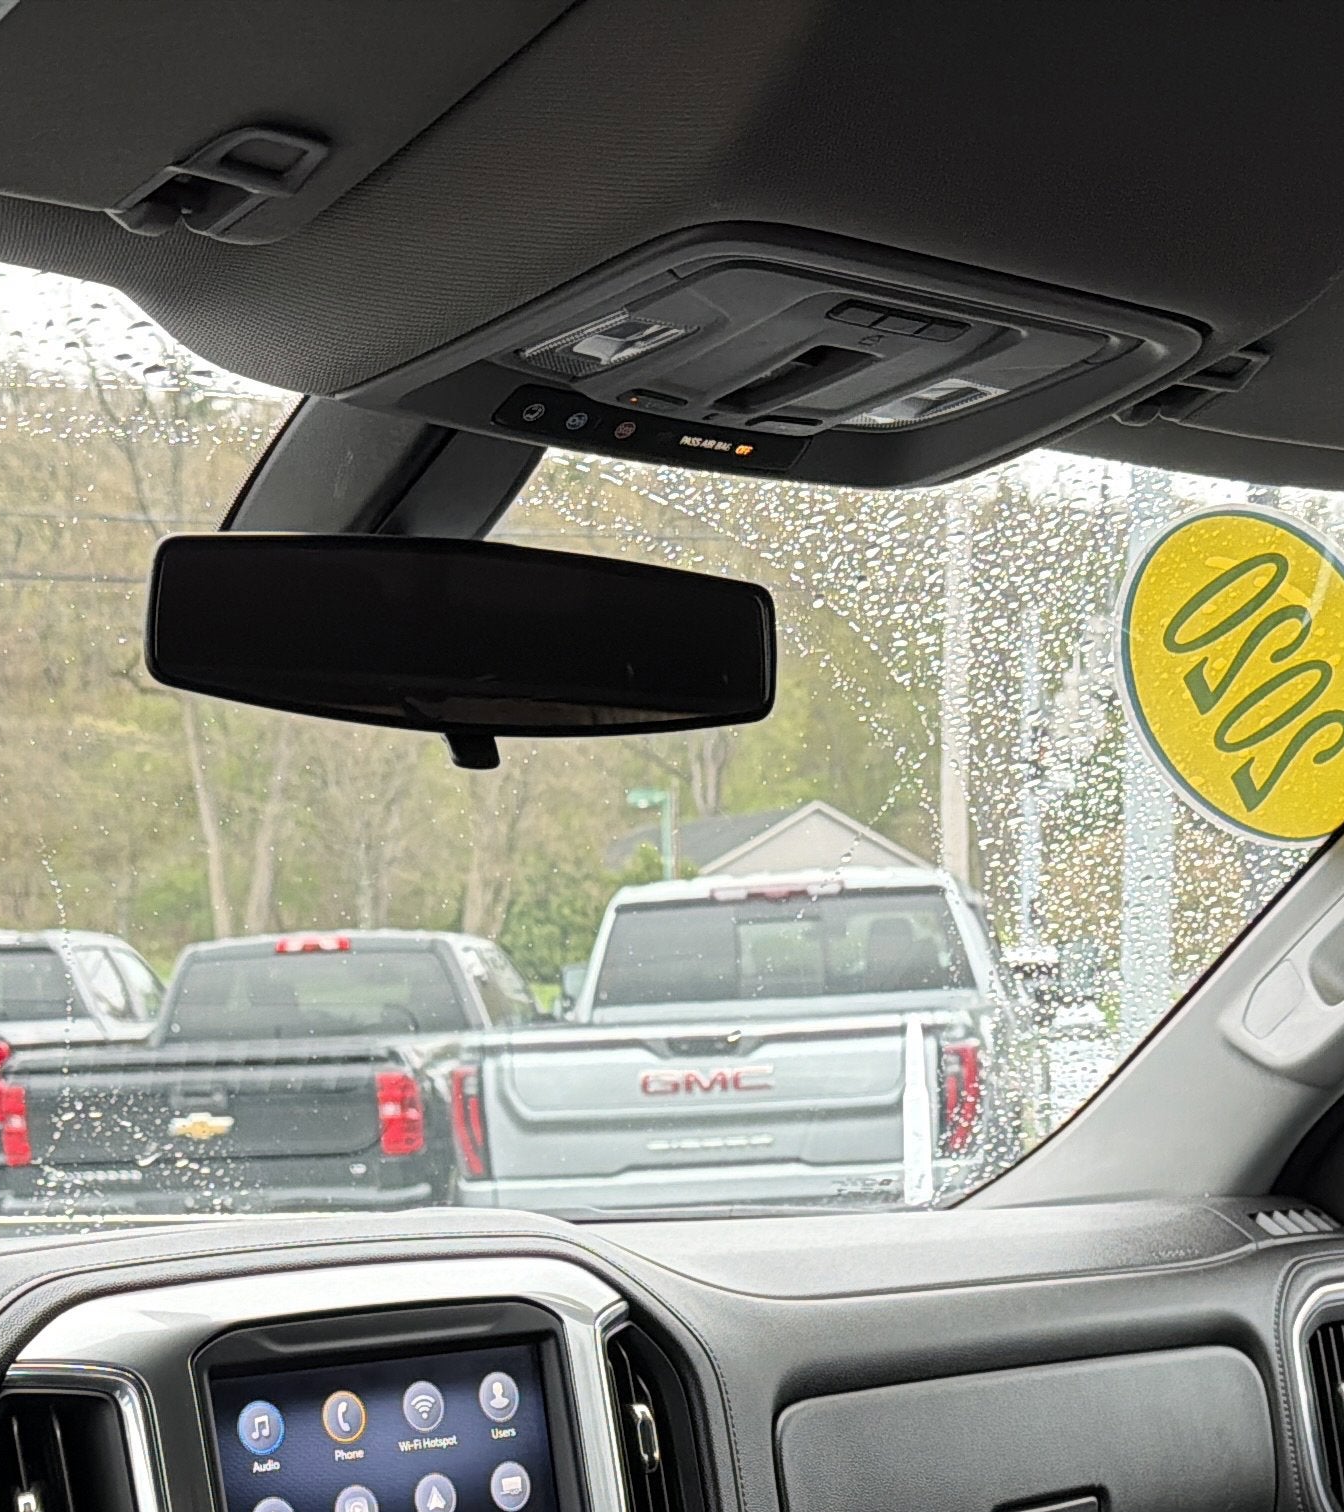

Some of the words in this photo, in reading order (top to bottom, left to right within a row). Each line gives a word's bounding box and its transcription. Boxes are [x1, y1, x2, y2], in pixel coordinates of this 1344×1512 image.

[640, 1063, 775, 1096] GMC
[491, 1427, 516, 1440] Users
[398, 1438, 422, 1452] Wi-Fi
[422, 1435, 458, 1449] Hotspot
[334, 1449, 364, 1462] Phone
[252, 1459, 281, 1473] Audio
